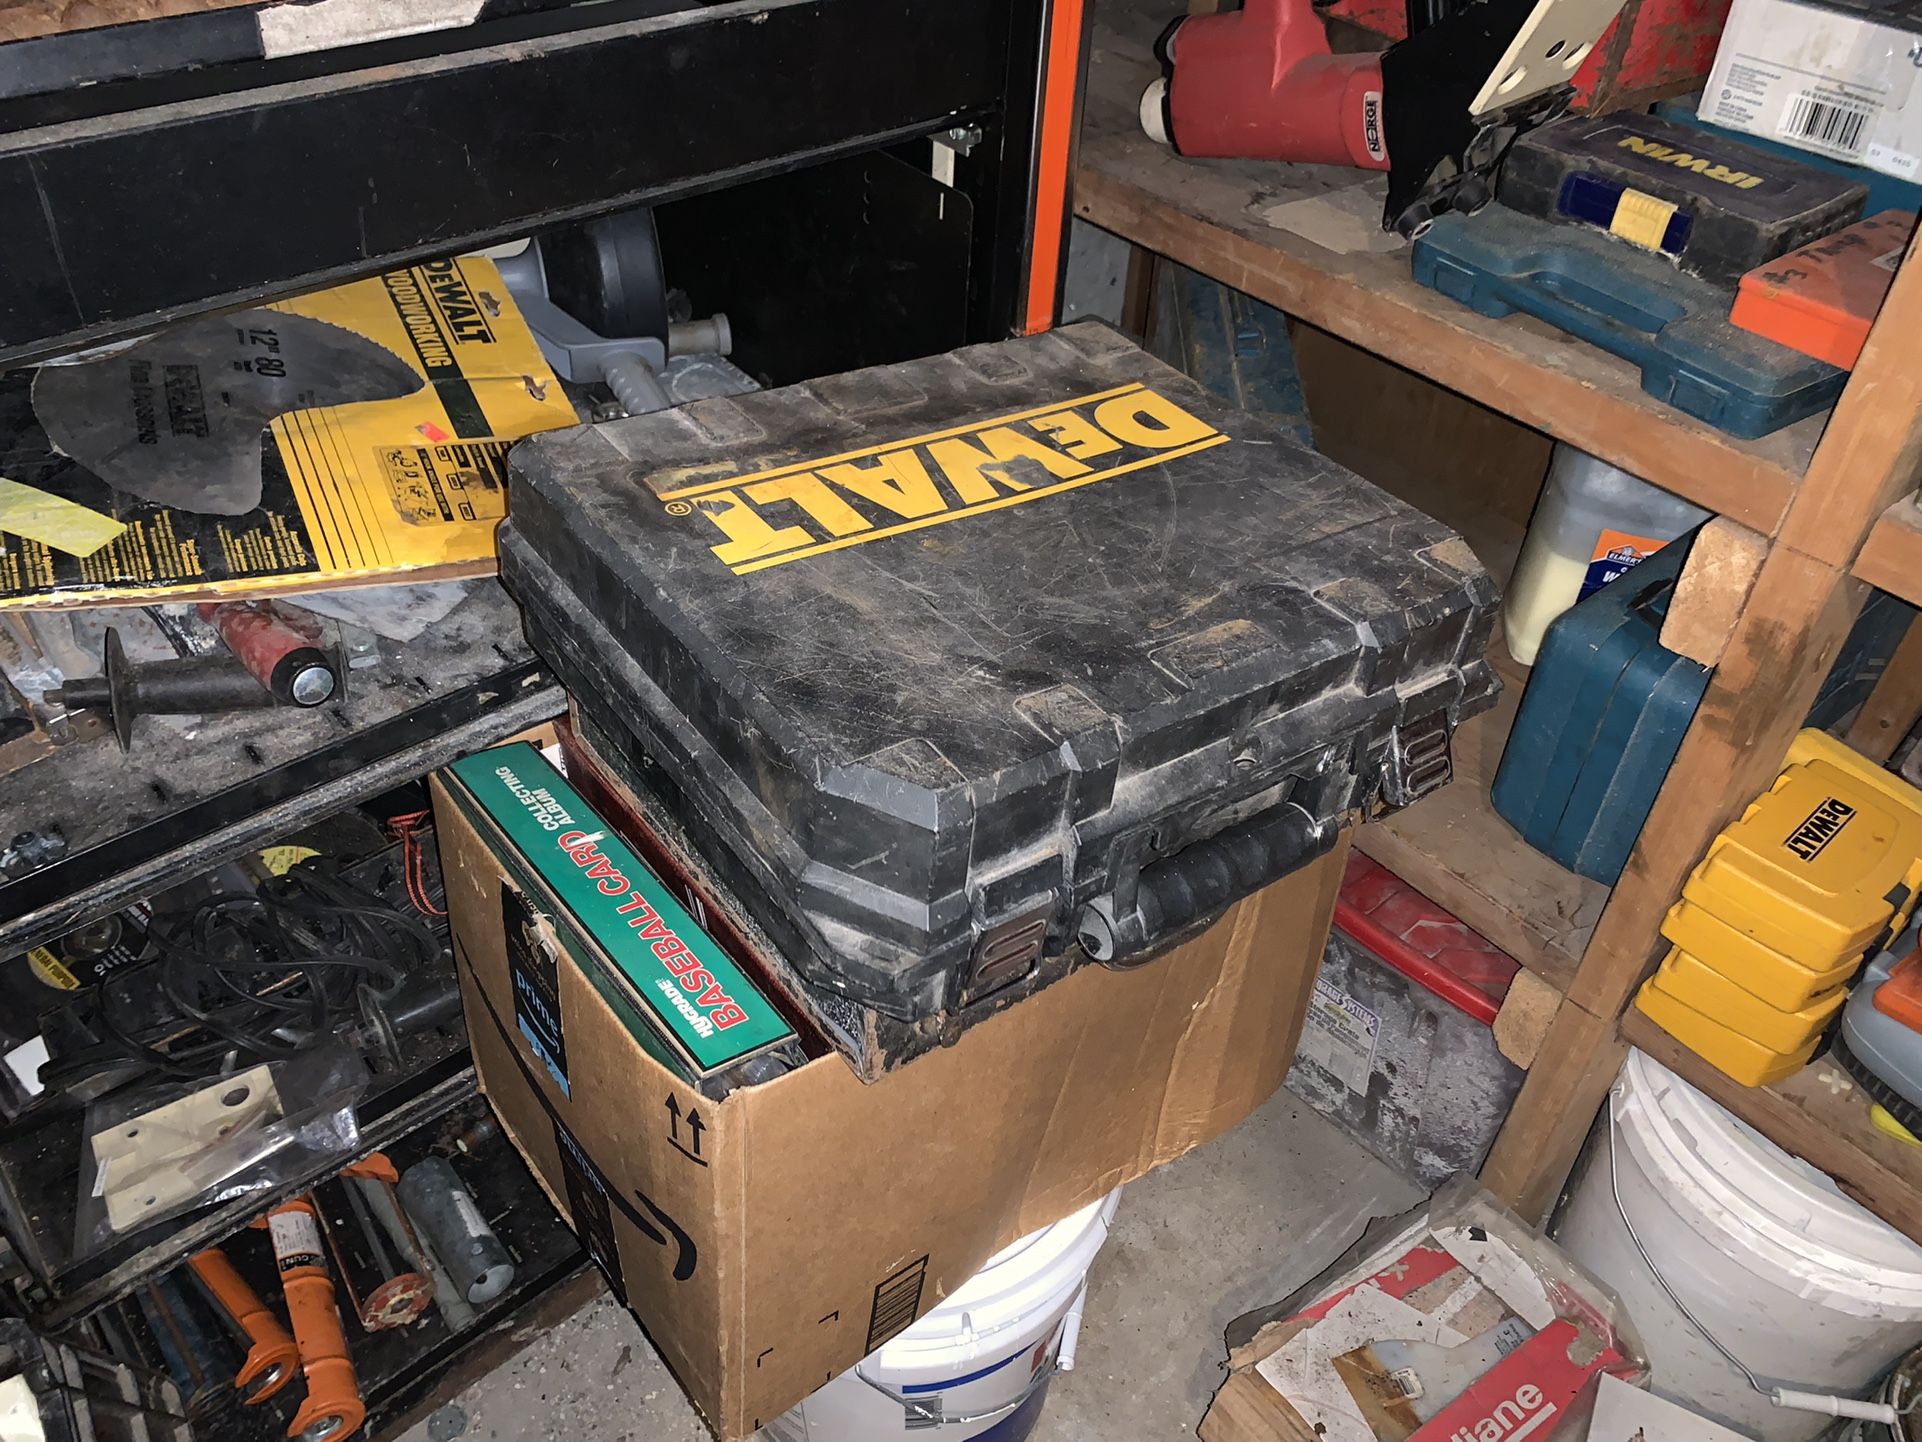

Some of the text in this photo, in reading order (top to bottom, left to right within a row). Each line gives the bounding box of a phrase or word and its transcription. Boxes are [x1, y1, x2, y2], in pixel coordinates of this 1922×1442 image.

[1364, 98, 1382, 155] NORGE
[1617, 135, 1765, 190] IRWIN
[423, 259, 493, 343] DEWALT
[253, 357, 287, 378] 80
[695, 388, 1218, 565] DEWALT
[494, 763, 560, 831] COLLECTING
[534, 787, 575, 827] ALBUM
[1786, 798, 1853, 861] DEWALT
[557, 833, 748, 1030] BASEBALL CARD
[510, 969, 565, 1037] prime
[661, 979, 715, 1038] HYGRADE
[1338, 994, 1377, 1027] SYSTEMS
